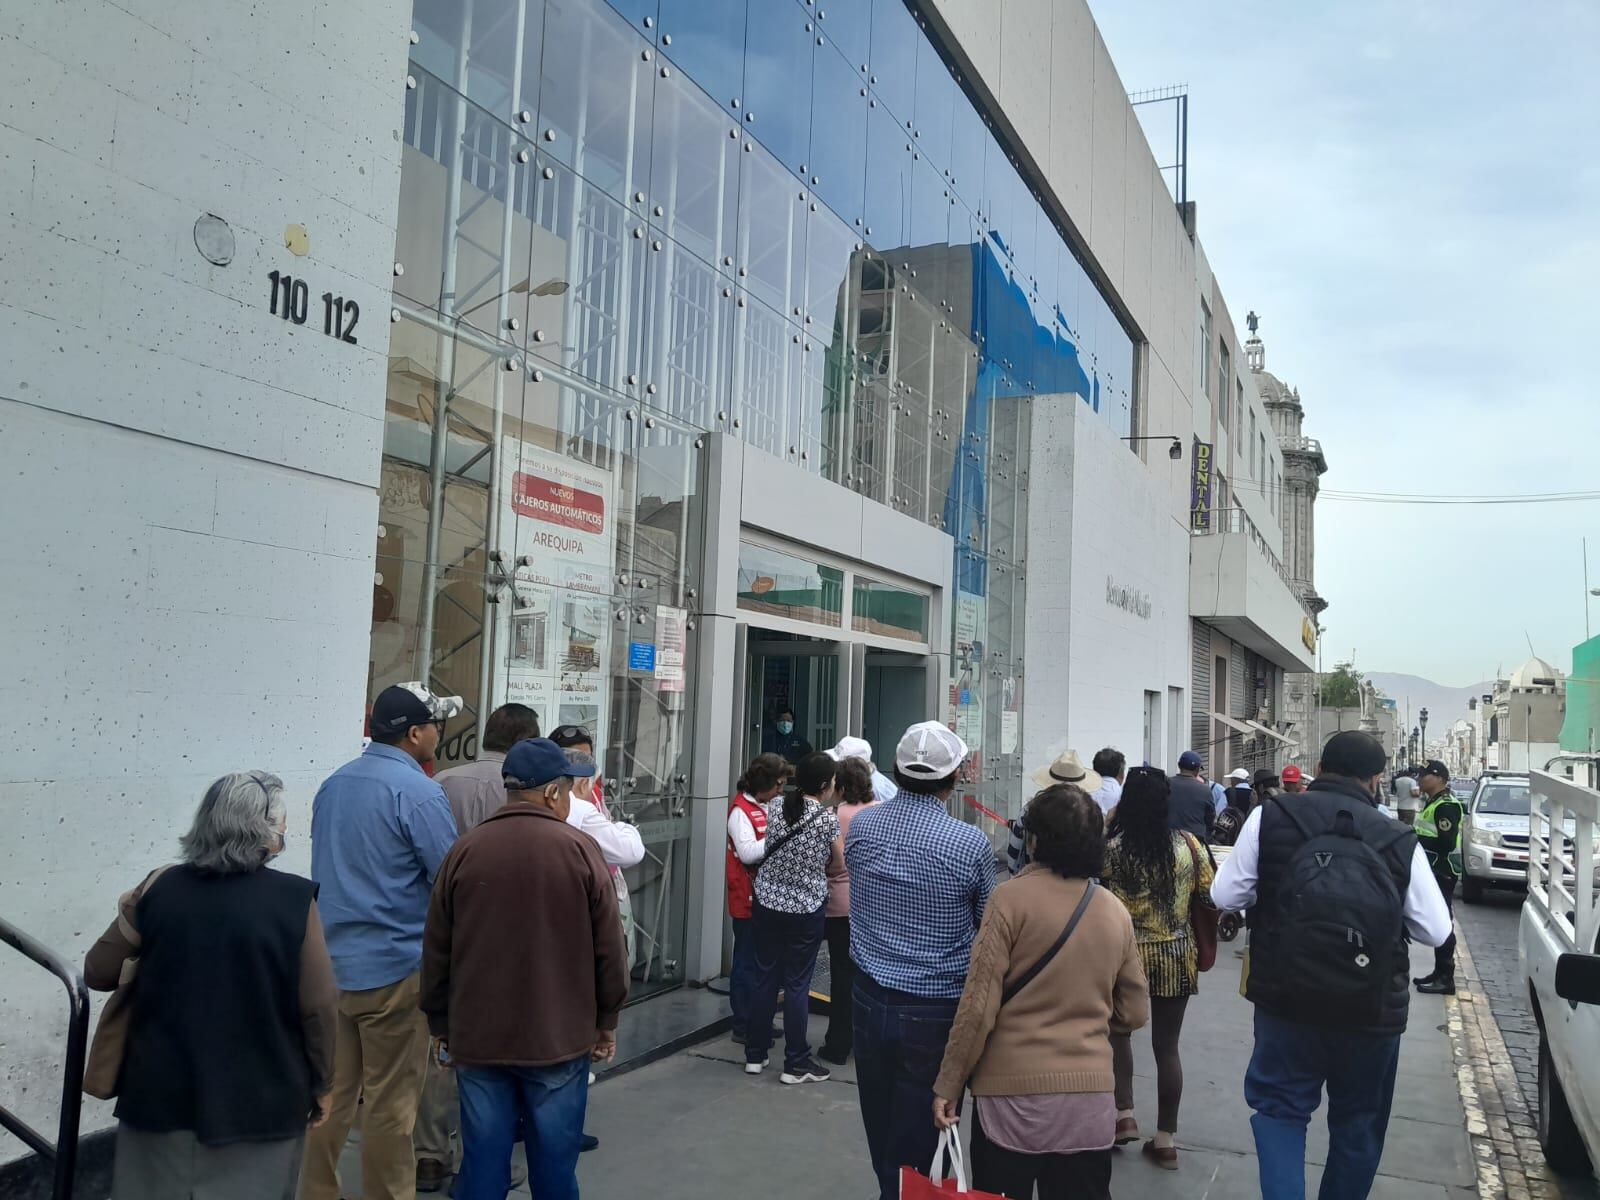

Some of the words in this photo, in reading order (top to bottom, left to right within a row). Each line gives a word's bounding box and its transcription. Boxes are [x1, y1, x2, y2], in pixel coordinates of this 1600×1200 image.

[268, 270, 308, 325] 110
[322, 292, 360, 345] 112
[550, 487, 575, 501] NUEVOS
[1195, 444, 1210, 526] DENTAL
[514, 492, 549, 512] CAJEROS
[549, 503, 602, 526] AUTOMÁTICOS
[533, 531, 584, 555] AREQUIPA
